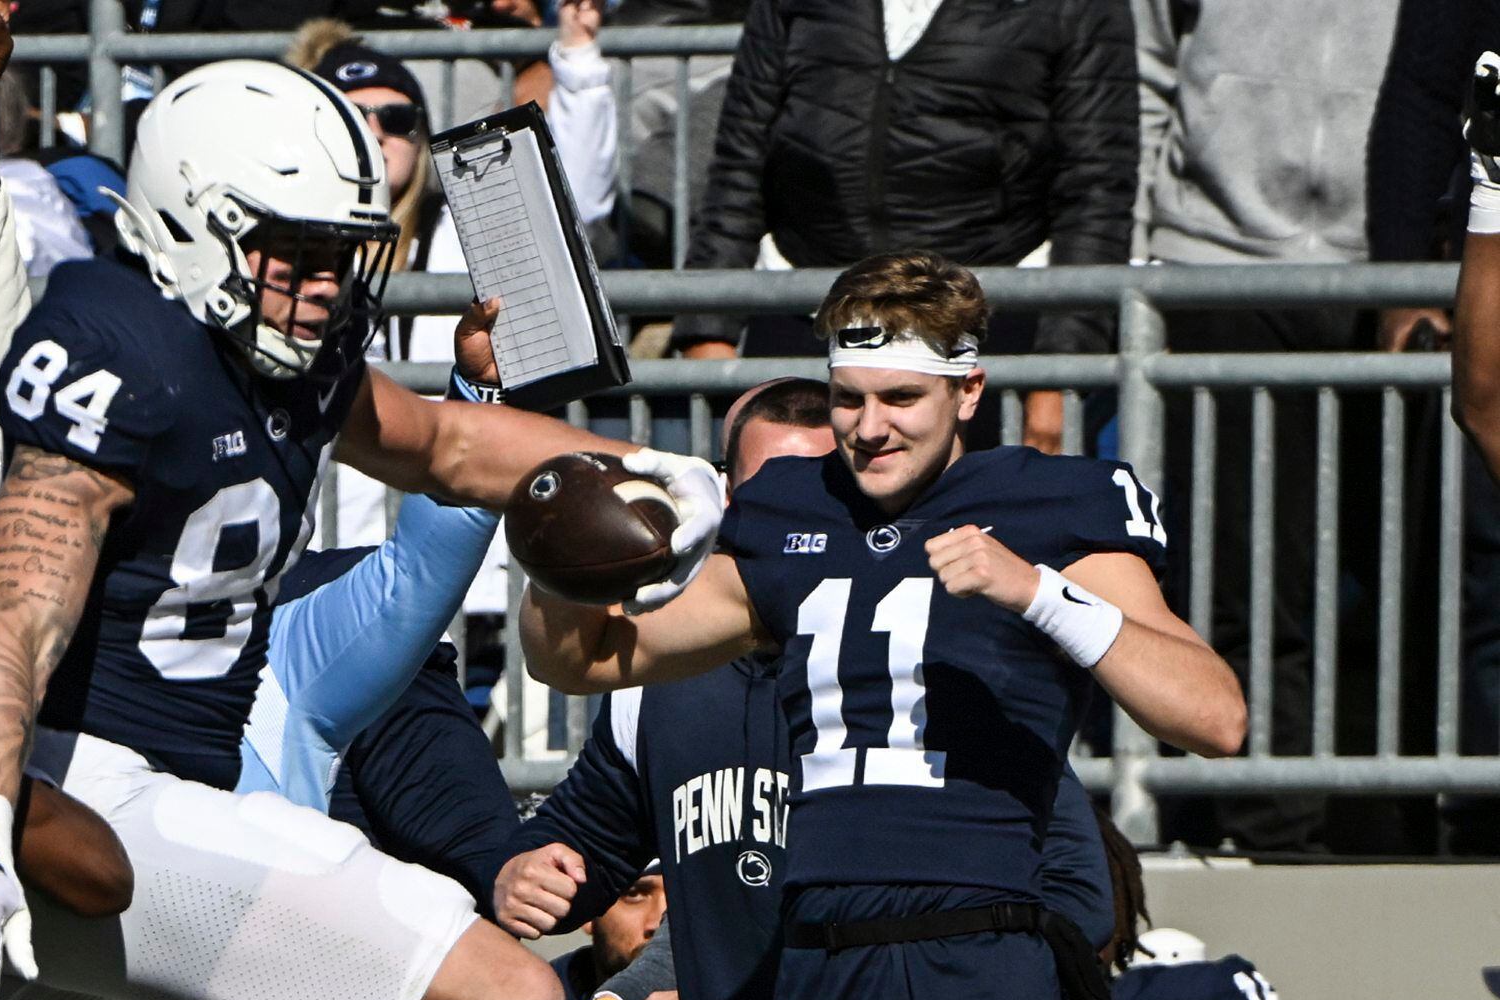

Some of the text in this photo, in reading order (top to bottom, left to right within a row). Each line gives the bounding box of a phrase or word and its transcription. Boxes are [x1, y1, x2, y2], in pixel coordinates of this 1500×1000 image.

[5, 339, 123, 454] 84
[138, 477, 300, 680] 8
[797, 577, 947, 793] 11
[673, 767, 745, 864] PENN
